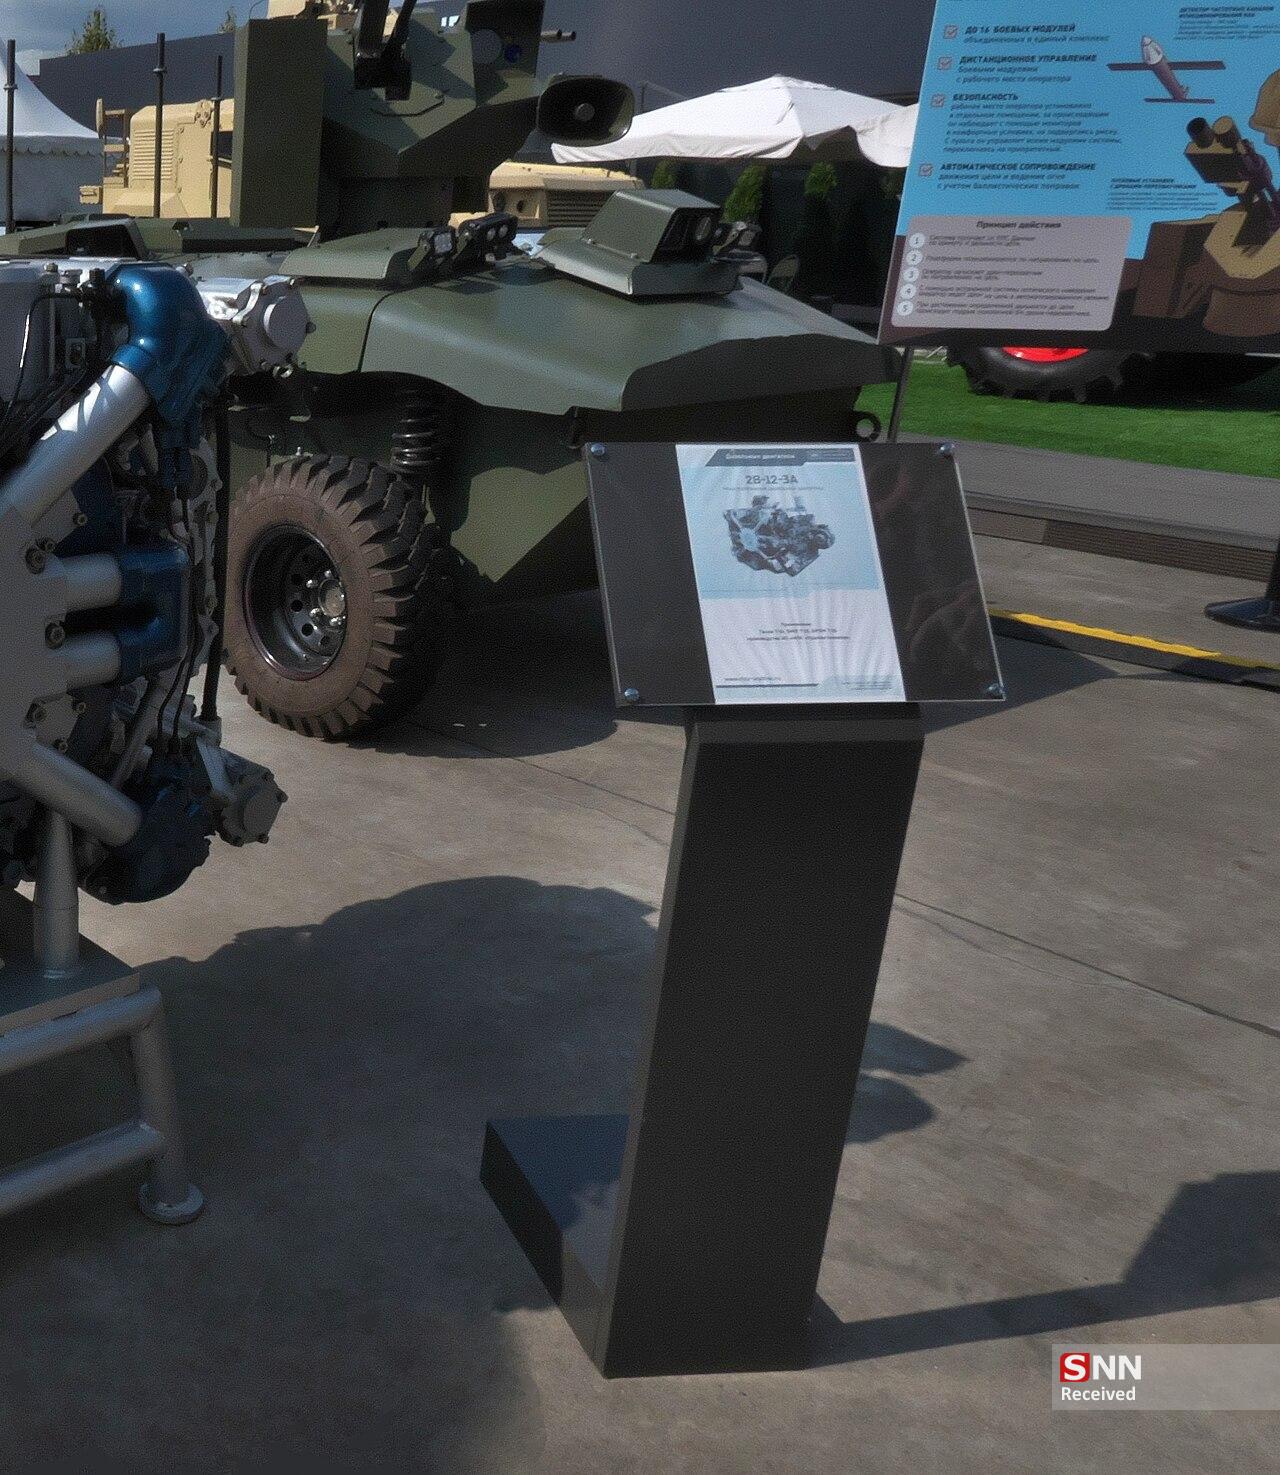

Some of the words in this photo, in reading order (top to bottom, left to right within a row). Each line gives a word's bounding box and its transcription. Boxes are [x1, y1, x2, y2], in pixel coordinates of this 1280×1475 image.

[965, 25, 978, 34] ДО
[979, 25, 990, 34] 16
[993, 25, 1031, 34] БОЕВЫХ
[1032, 23, 1076, 33] МОДУЛЕЙ
[959, 55, 1035, 65] ДИСТАНЦИОННОЕ
[1037, 54, 1097, 63] УПРАВЛЕНИЕ
[953, 93, 1019, 101] БЕЗОПАСНОСТЬ
[1019, 163, 1096, 171] СОПРОВОЖДЕНИЕ
[976, 221, 1017, 230] Принцип
[1018, 220, 1062, 229] действия
